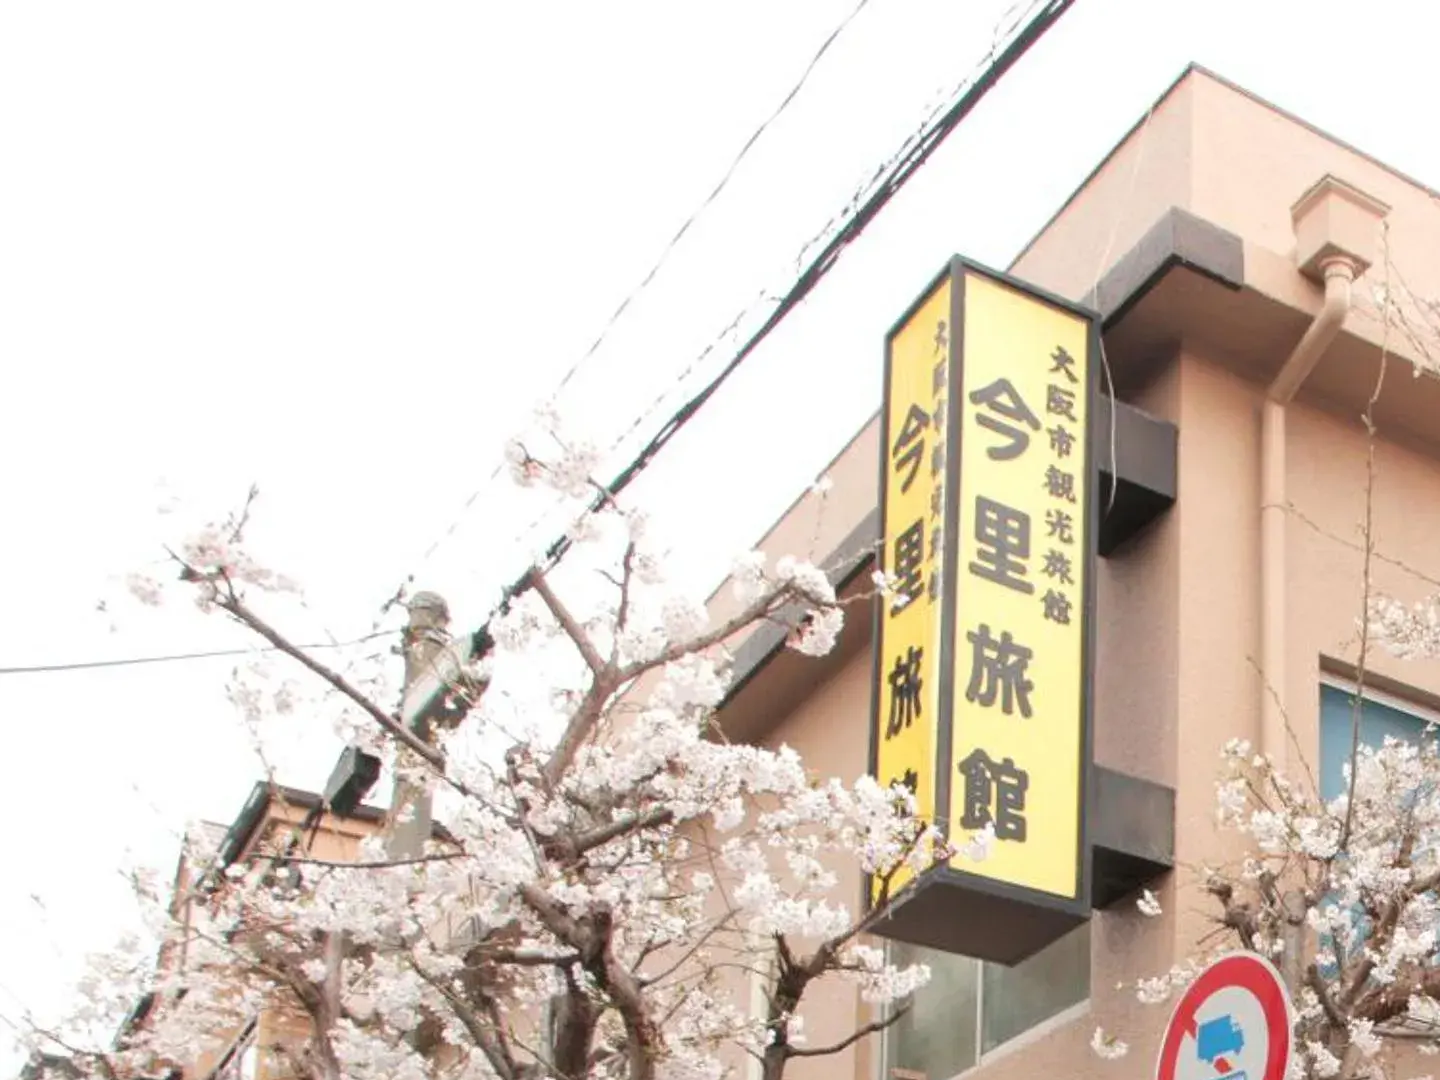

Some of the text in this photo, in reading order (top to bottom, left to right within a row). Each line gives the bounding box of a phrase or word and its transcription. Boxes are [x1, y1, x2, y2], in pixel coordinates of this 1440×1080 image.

[958, 378, 1041, 843] 今里旅館
[1040, 345, 1079, 625] 大阪市観光旅館
